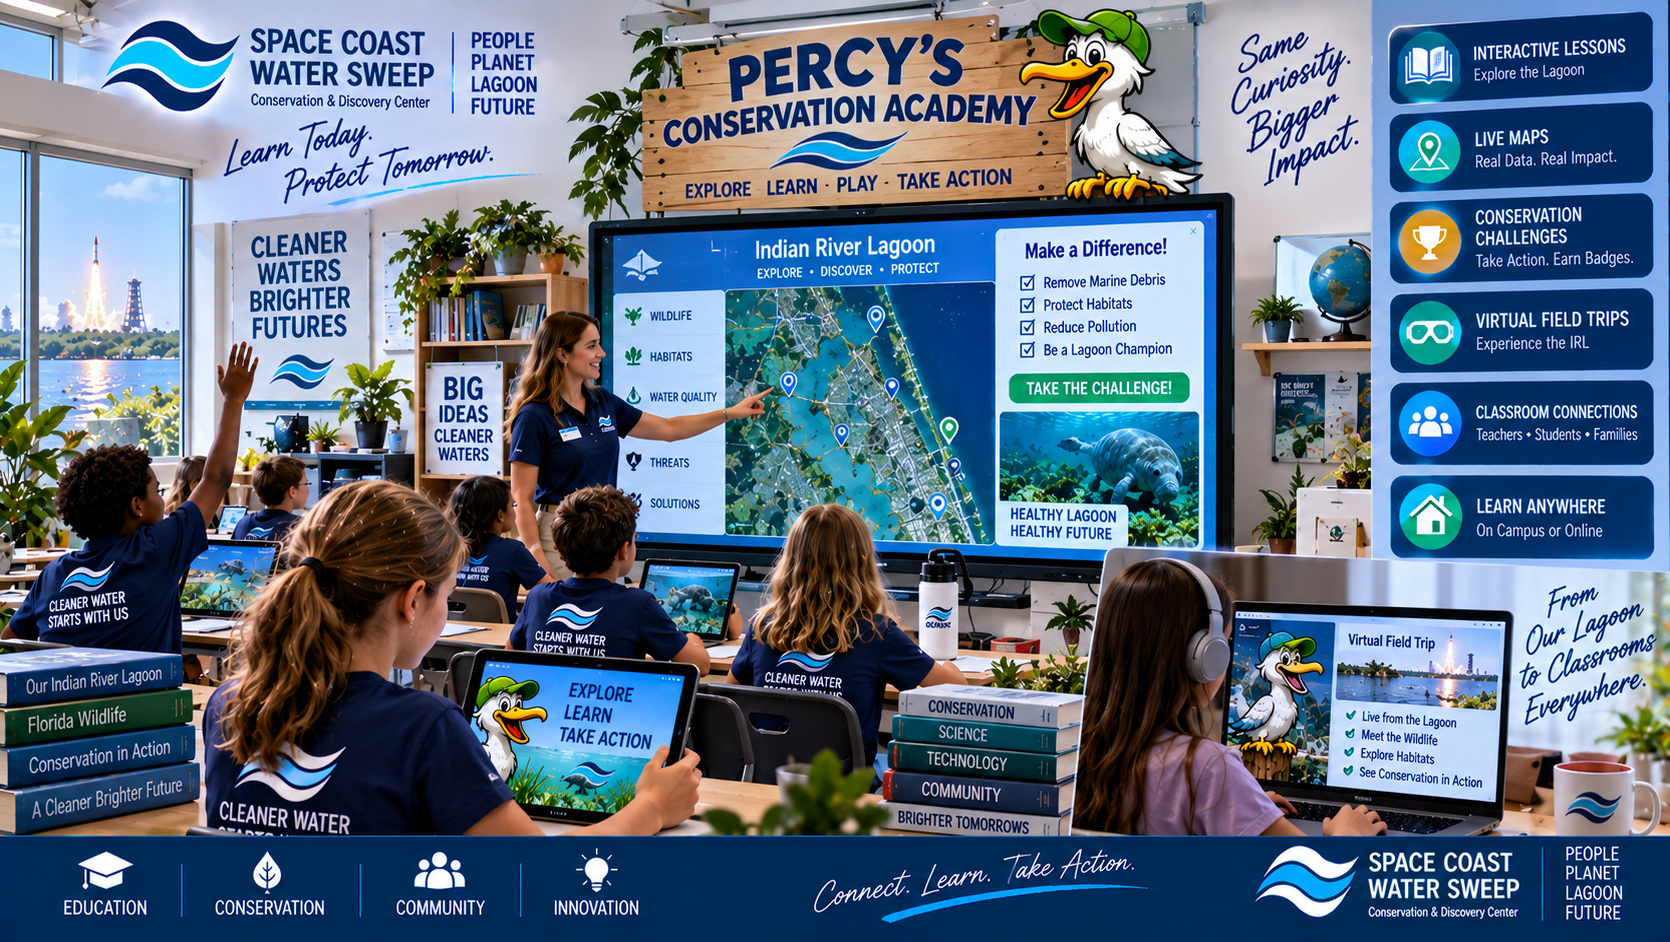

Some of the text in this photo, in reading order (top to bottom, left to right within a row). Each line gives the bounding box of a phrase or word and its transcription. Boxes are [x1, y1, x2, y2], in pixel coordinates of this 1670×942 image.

[250, 28, 425, 56] SPACE COAST
[472, 32, 534, 49] PEOPLE
[472, 54, 535, 71] PLANET
[1238, 32, 1309, 73] Same
[250, 60, 434, 87] WATER SWEEP
[728, 33, 966, 101] PERCY'S
[472, 76, 537, 93] LAGOON
[1231, 41, 1351, 115] Curiosity.
[251, 93, 430, 111] Conservation & Discovery Center
[471, 98, 535, 115] FUTURE
[662, 94, 1037, 148] CONSERVATION ACADEMY
[1246, 94, 1340, 153] Bigger
[223, 118, 372, 177] Learn Today.
[1264, 114, 1359, 186] Impact.
[284, 146, 493, 204] Protect Tomorrow.
[685, 168, 1012, 199] EXPLORE LEARN PLAY TAKE ACTION
[251, 230, 347, 258] CLEANER
[756, 236, 935, 259] Indian River Lagoon
[1026, 238, 1167, 259] Make a Difference!
[257, 258, 341, 285] WATERS
[757, 262, 940, 279] EXPLORE DISCOVER PROTECT
[1044, 273, 1166, 289] Remove Marine Debris
[250, 286, 350, 312] BRIGHTER
[1044, 297, 1132, 311] Protect Habitats
[650, 310, 692, 321] WILDLIFE
[1044, 319, 1136, 333] Reduce Pollution
[253, 314, 347, 339] FUTURES
[650, 351, 693, 362] HABITATS
[444, 376, 483, 400] BIG
[650, 392, 717, 403] WATER QUALITY
[1026, 381, 1172, 395] TAKE THE CHALLENGE!
[439, 405, 488, 423] IDEAS
[434, 428, 493, 443] CLEANER
[438, 447, 489, 461] WATERS
[650, 457, 690, 468] THREATS
[650, 498, 700, 510] SOLUTIONS
[1011, 507, 1116, 523] HEALTHY LAGOON
[1011, 524, 1112, 540] HEALTHY FUTURE
[49, 591, 125, 612] CLEANER WATER
[48, 607, 129, 629] STARTS WITH US
[535, 630, 606, 646] CLEANER WATER
[1348, 633, 1435, 653] Virtual Field Trip
[26, 669, 162, 695] Our Indian River Lagoon
[765, 671, 842, 689] CLEANER WATER
[569, 682, 634, 703] EXPLORE
[28, 706, 126, 733] Florida Wildlife
[564, 704, 613, 723] LEARN
[928, 699, 1015, 720] CONSERVATION
[560, 726, 653, 750] TAKE ACTION
[939, 725, 988, 742] SCIENCE
[1361, 729, 1438, 746] Meet the Wildlife
[29, 740, 170, 774] Conservation in Action
[927, 751, 1008, 771] TECHNOLOGY
[32, 780, 183, 819] A Cleaner Brighter Future
[922, 781, 1001, 802] COMMUNITY
[219, 801, 350, 835] CLEANER WATER
[898, 810, 1029, 834] BRIGHTER TOMORROWS
